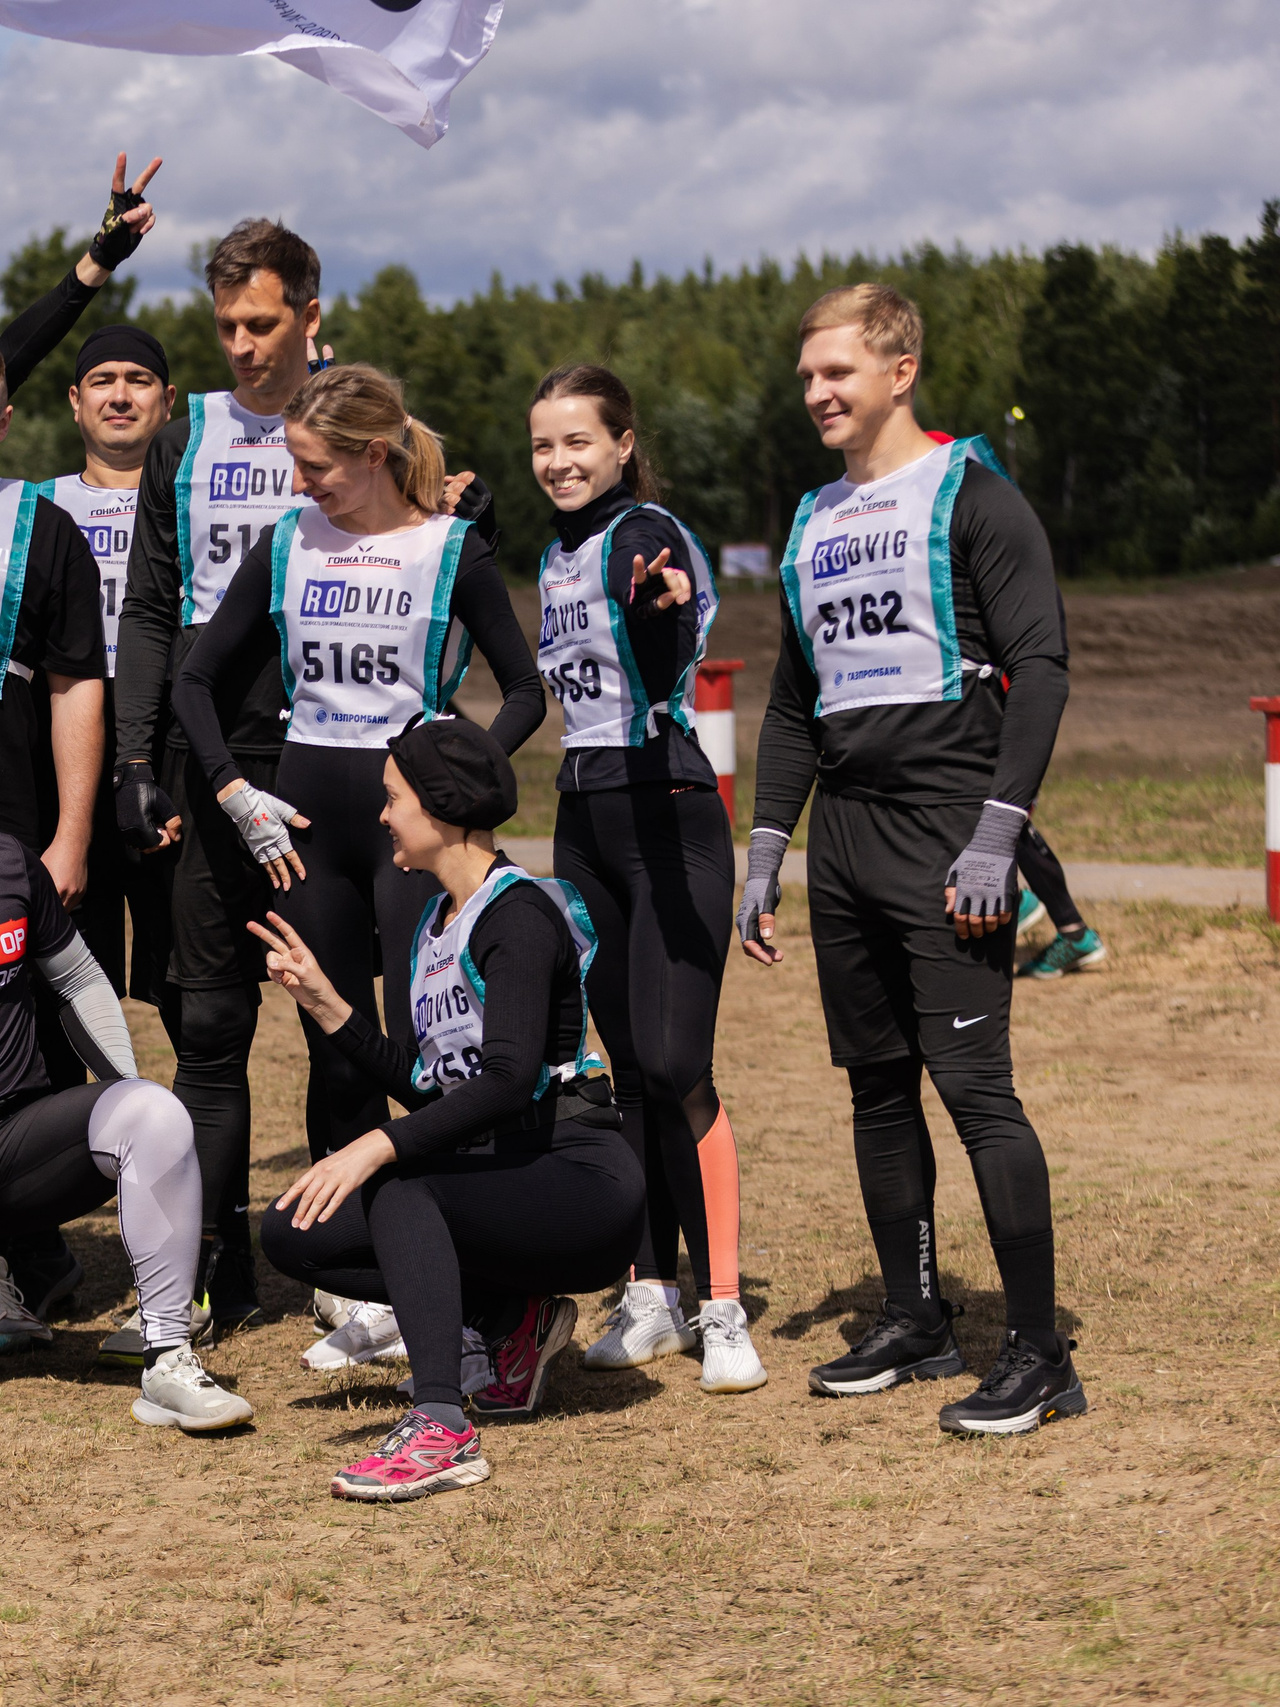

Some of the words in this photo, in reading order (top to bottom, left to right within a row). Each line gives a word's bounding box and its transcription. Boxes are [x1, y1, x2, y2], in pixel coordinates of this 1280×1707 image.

[231, 436, 263, 446] ГОНКА
[90, 506, 122, 517] ГОНКА
[834, 506, 859, 520] ГОНКА
[861, 499, 897, 512] ГЕРОЕВ
[328, 556, 359, 565] ГОНКА
[361, 556, 401, 567] ГЕРОЕВ
[814, 530, 908, 576] RODVIG
[304, 585, 412, 617] RODVIG
[818, 590, 910, 645] 5162
[302, 641, 400, 686] 5165
[847, 666, 903, 682] ГАЗПРОМБАНК
[331, 712, 389, 725] ГАЗПРОМБАНК
[918, 1219, 931, 1300] ATHLEX
